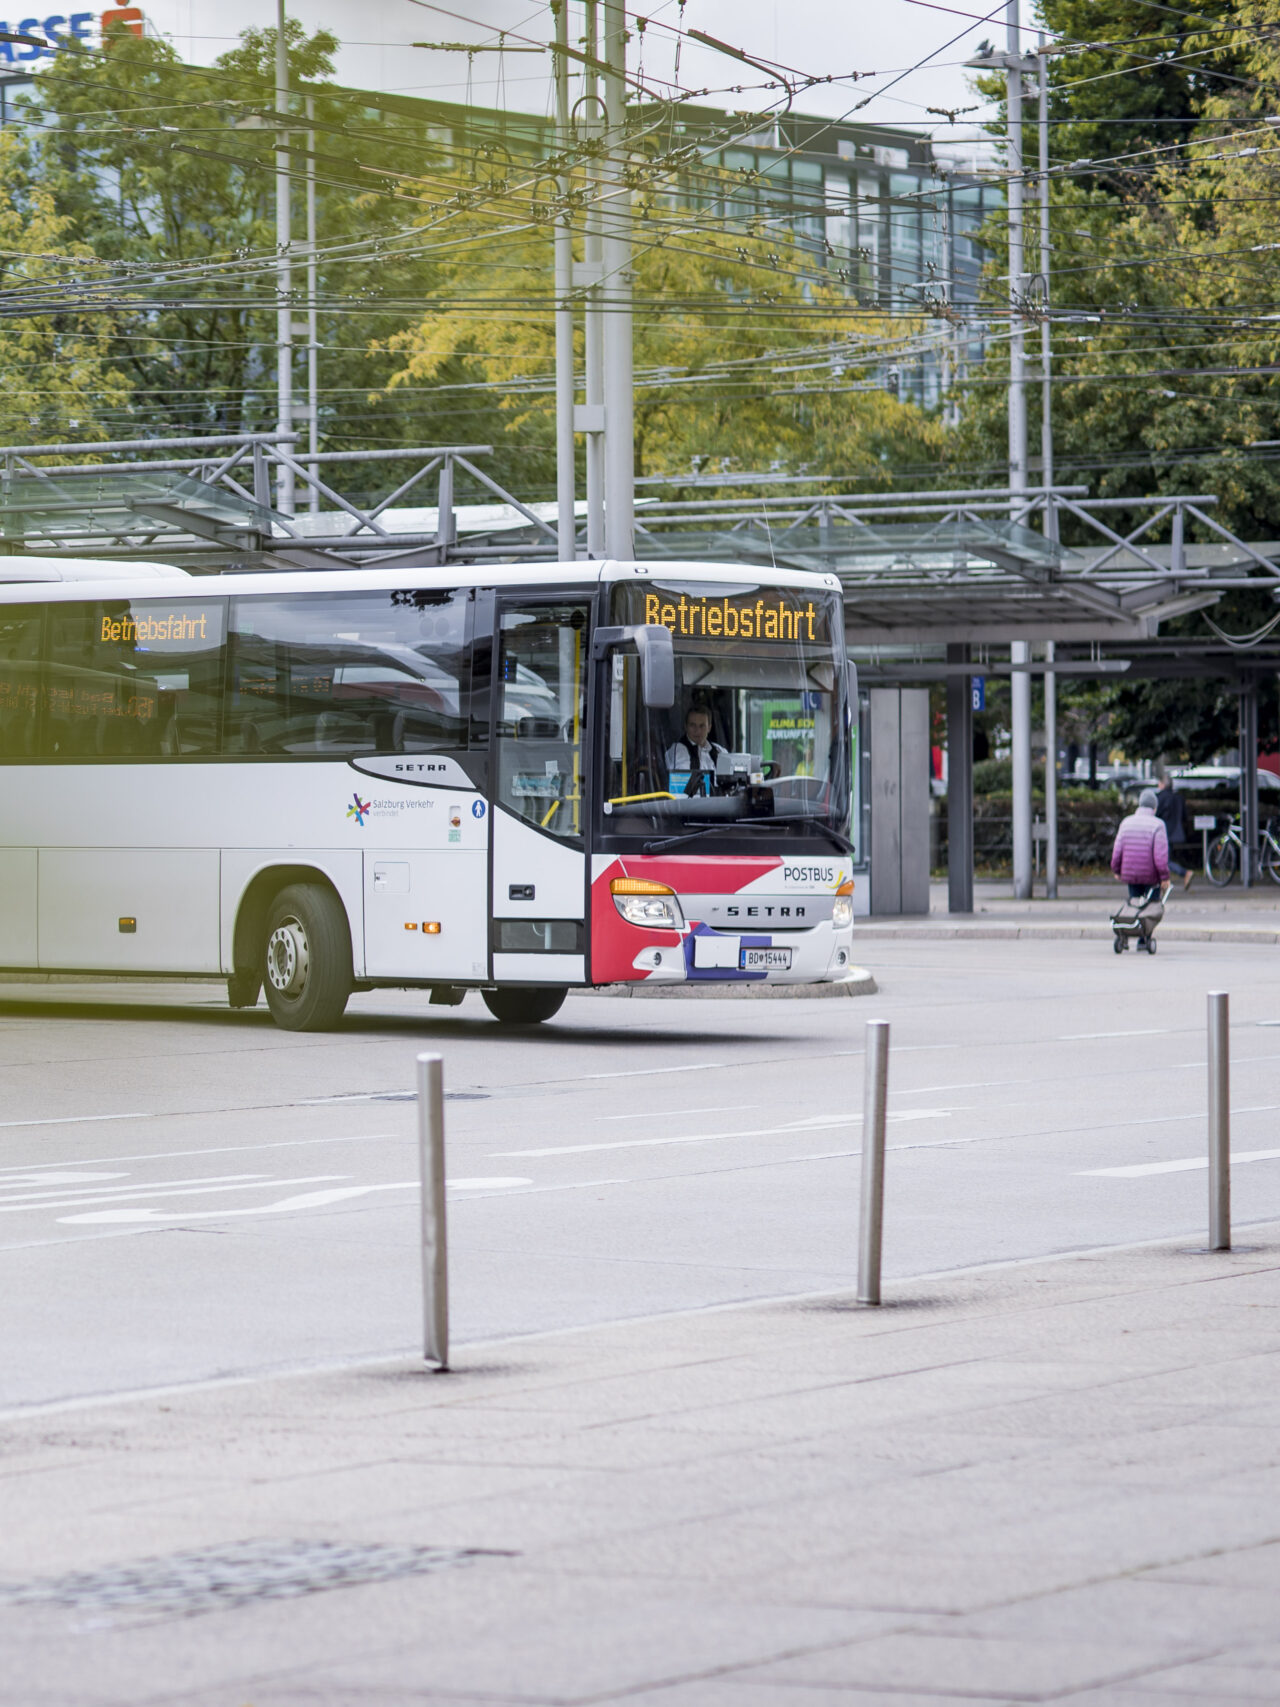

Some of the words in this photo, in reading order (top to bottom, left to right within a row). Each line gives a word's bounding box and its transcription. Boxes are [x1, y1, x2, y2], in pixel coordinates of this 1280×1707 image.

[645, 594, 816, 640] Betriebsfahrt
[101, 613, 207, 641] Betriebsfahrt
[972, 689, 981, 710] B
[770, 718, 795, 729] KLIMA
[373, 799, 405, 810] Salzburg
[405, 799, 434, 809] Verkehr
[784, 867, 834, 882] POSTBUS
[727, 906, 805, 917] SETRA
